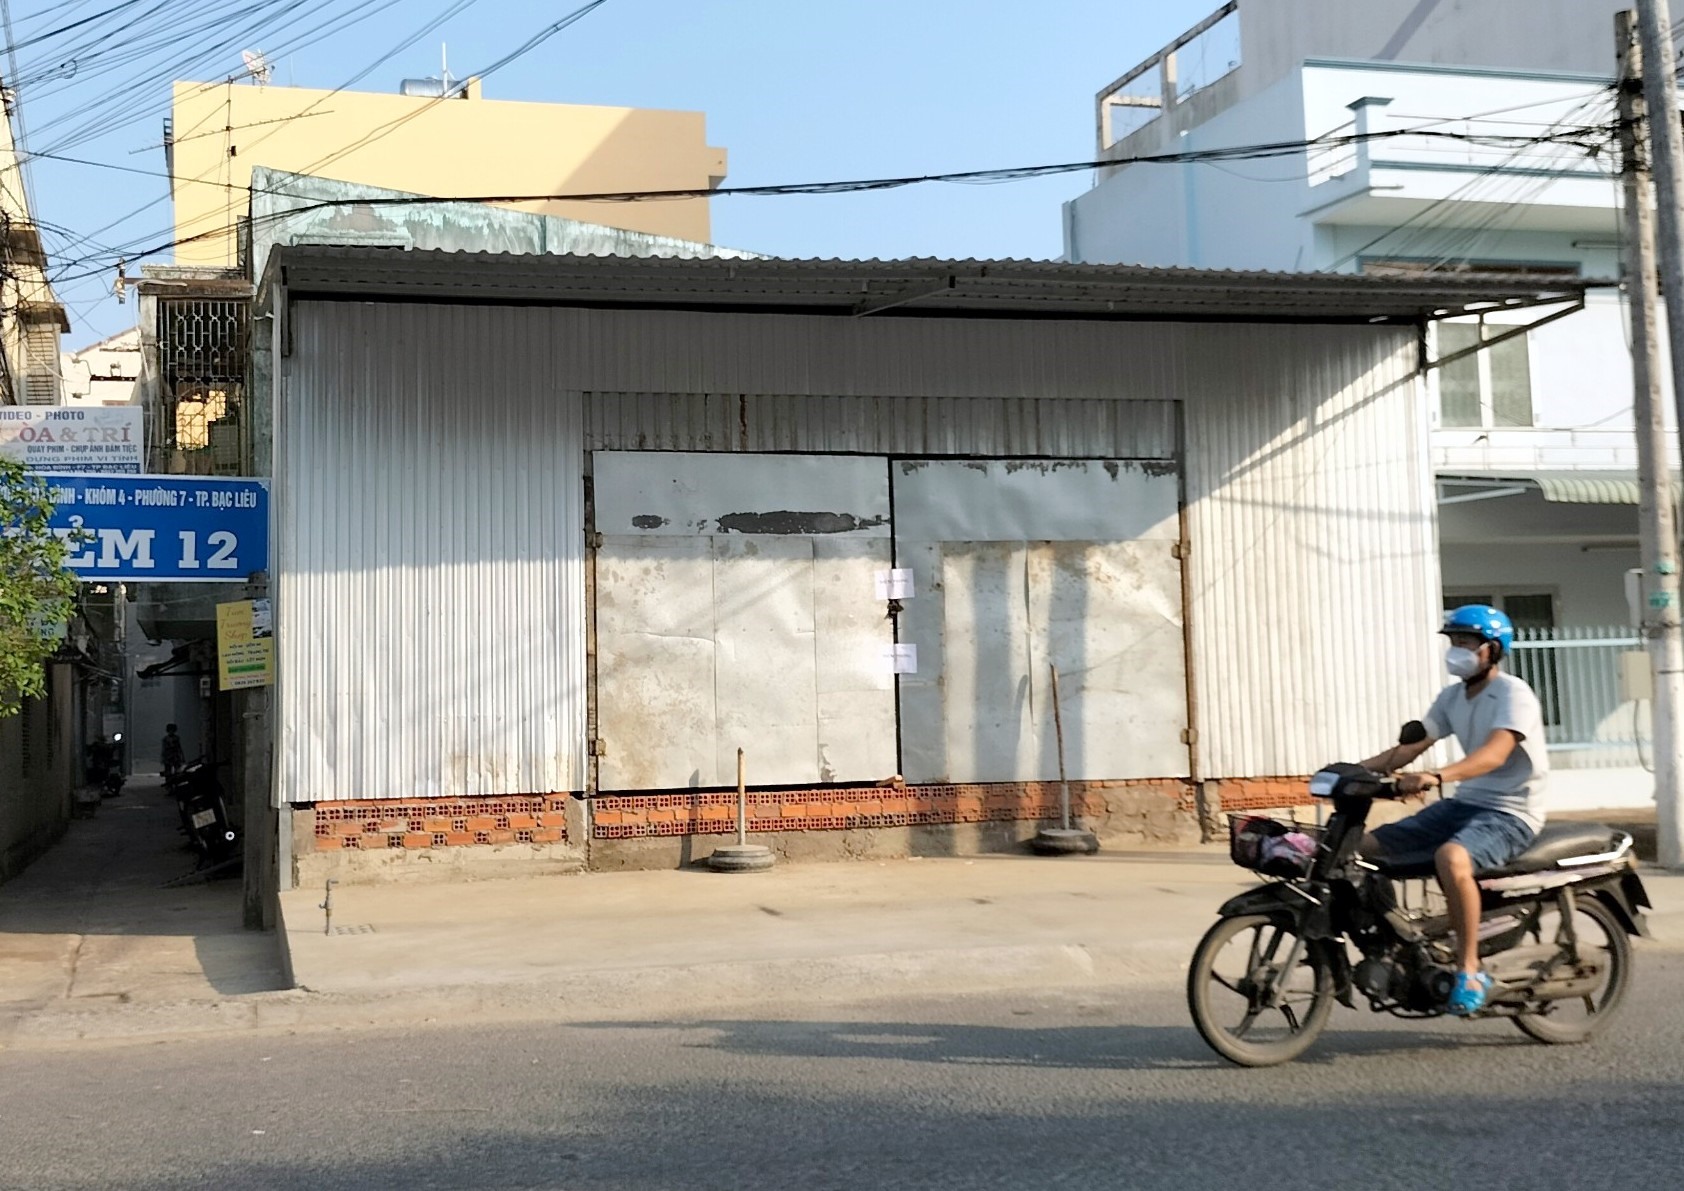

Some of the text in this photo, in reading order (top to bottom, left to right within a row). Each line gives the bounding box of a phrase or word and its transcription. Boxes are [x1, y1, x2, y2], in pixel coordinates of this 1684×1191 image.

[45, 411, 85, 420] PHOTO
[19, 422, 132, 443] ÒA & TRÍ
[27, 445, 45, 453] QUAY
[47, 445, 65, 453] PHIM
[84, 485, 117, 506] KHÓM
[118, 489, 126, 506] 4
[134, 485, 178, 506] PHƯỜNG
[179, 490, 187, 507] 7
[195, 490, 210, 507] TP.
[211, 491, 233, 511] BẠC
[234, 488, 257, 508] LIÊU
[178, 530, 238, 569] 12
